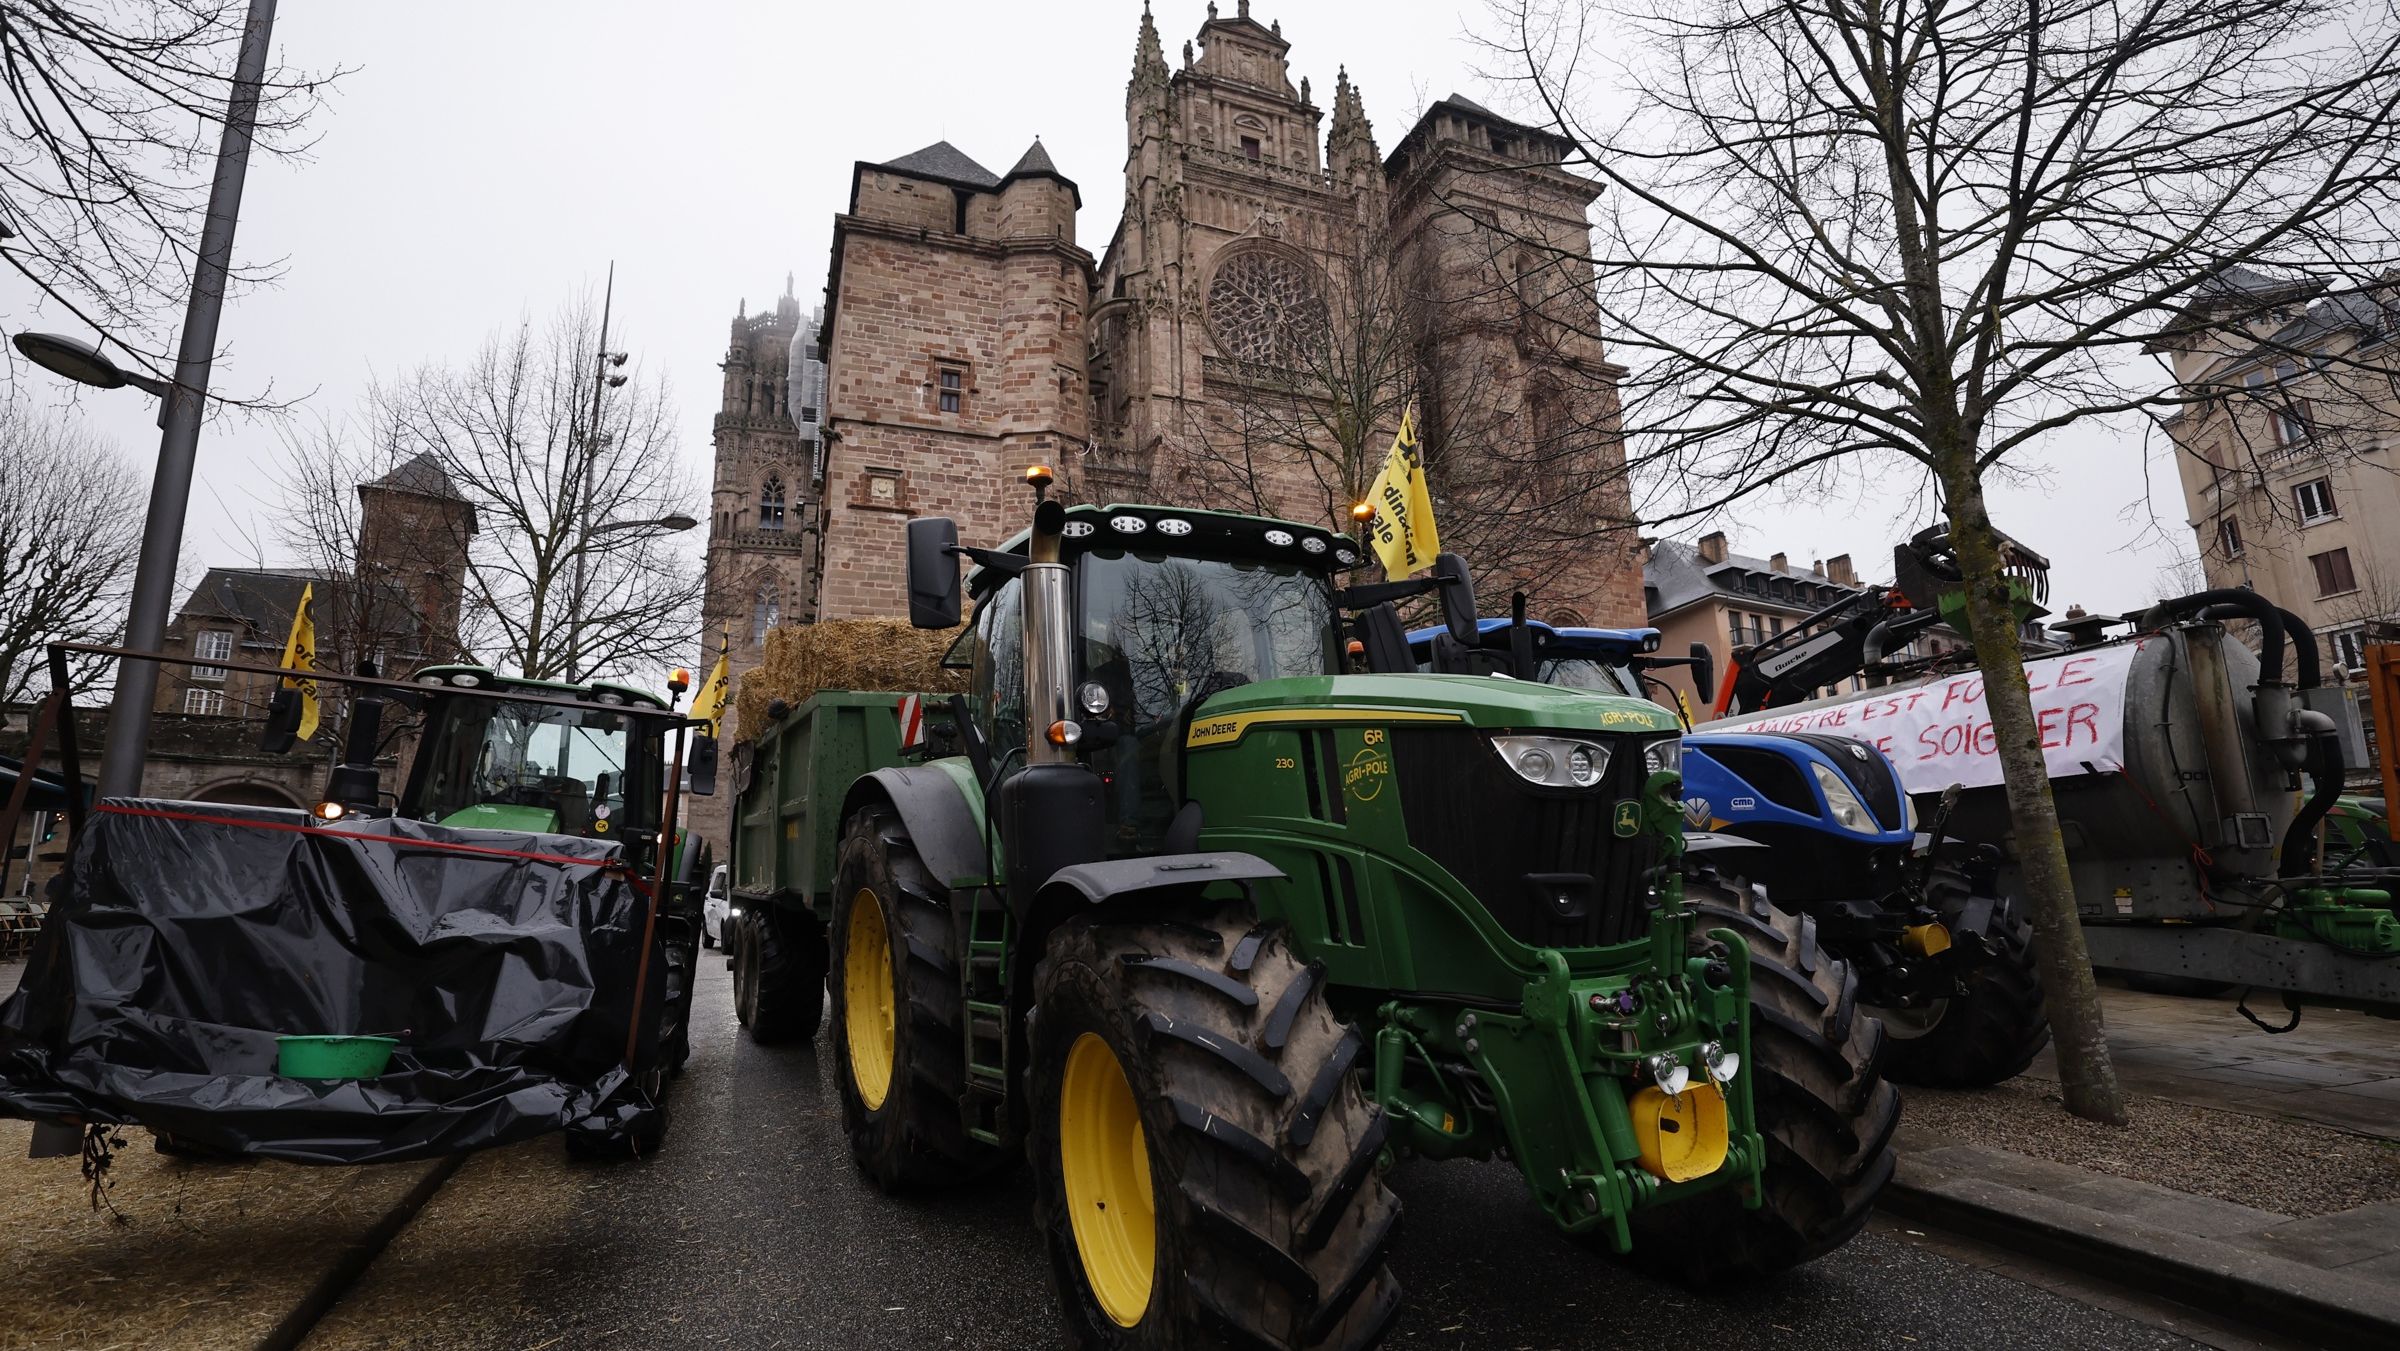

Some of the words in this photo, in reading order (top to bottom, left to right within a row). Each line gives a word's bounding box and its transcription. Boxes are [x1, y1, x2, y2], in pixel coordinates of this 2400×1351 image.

[1861, 691, 1928, 721] EST
[1941, 676, 1986, 712] FO
[1599, 710, 1656, 729] AGRI-POLE
[1192, 727, 1211, 739] JOHN
[1211, 721, 1238, 736] DEERE
[1363, 728, 1385, 746] 6R
[1275, 758, 1295, 769] 230
[1344, 760, 1388, 787] AGRI-POLE
